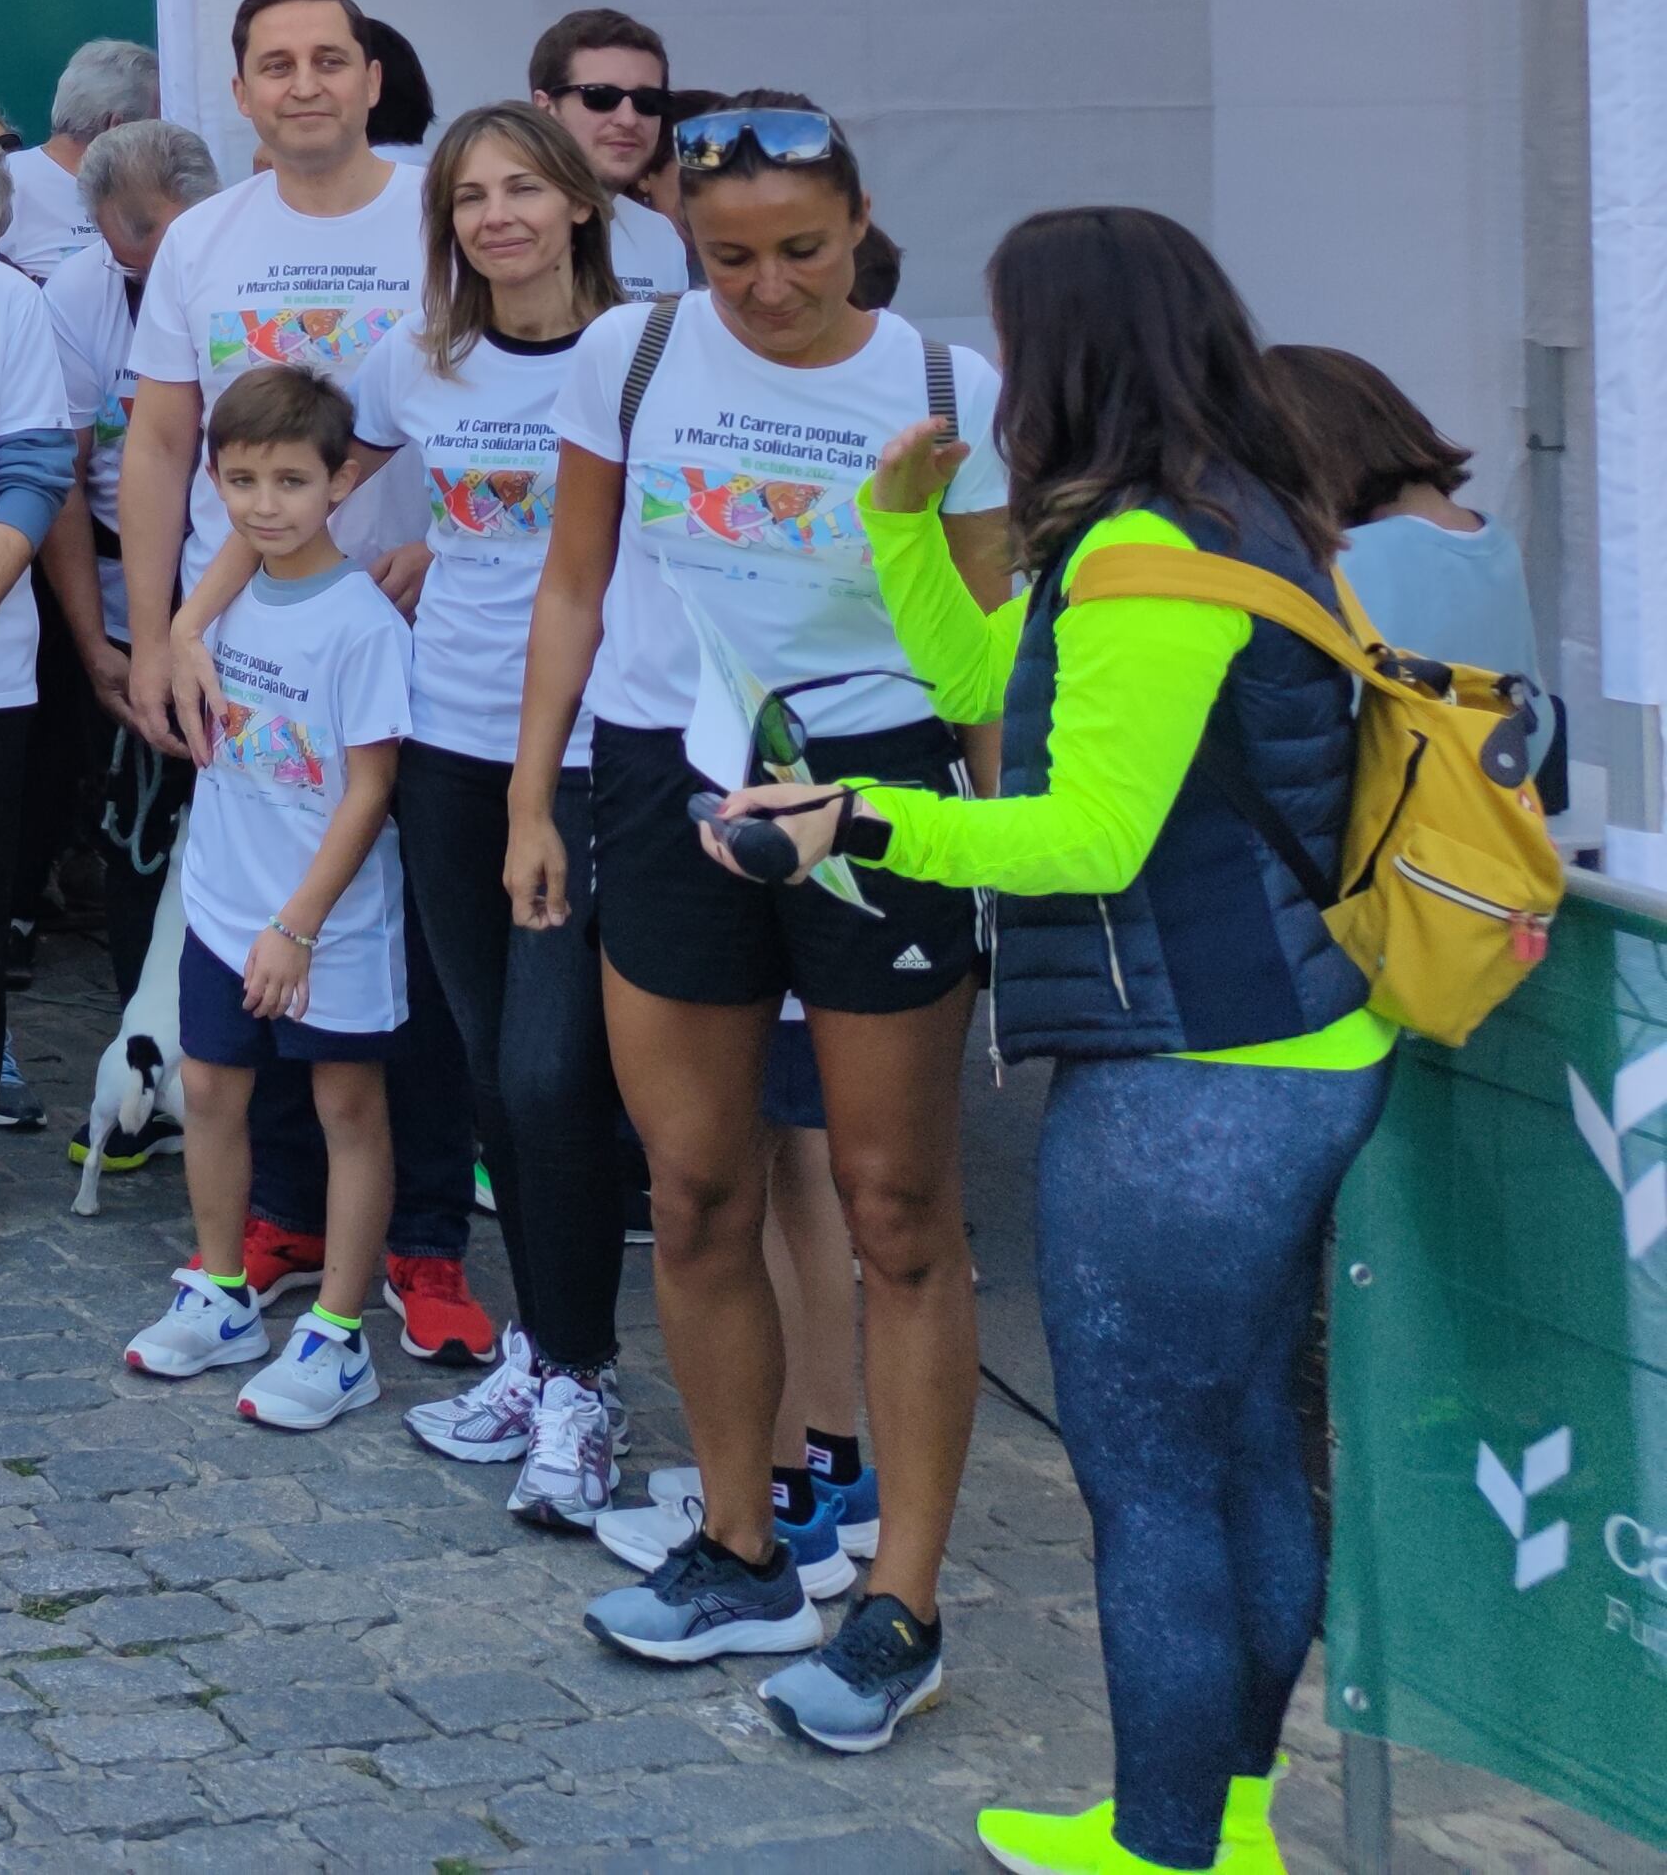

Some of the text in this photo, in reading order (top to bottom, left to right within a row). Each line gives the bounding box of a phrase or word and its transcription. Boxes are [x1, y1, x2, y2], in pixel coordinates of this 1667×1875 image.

[267, 264, 377, 278] XI Carrera popular
[237, 278, 410, 295] y Marcha solidaria Caja Rural
[456, 419, 520, 434] XI Carrera
[718, 411, 868, 447] XI Carrera popular
[432, 434, 478, 449] Marcha
[482, 438, 535, 451] solidaria
[674, 428, 862, 469] y Marcha solidaria Caja
[754, 459, 802, 477] octubre
[805, 465, 835, 480] 2022
[222, 644, 283, 677] Carrera popular
[225, 664, 257, 687] solidaria
[258, 675, 279, 695] Caja
[279, 684, 309, 703] Rural
